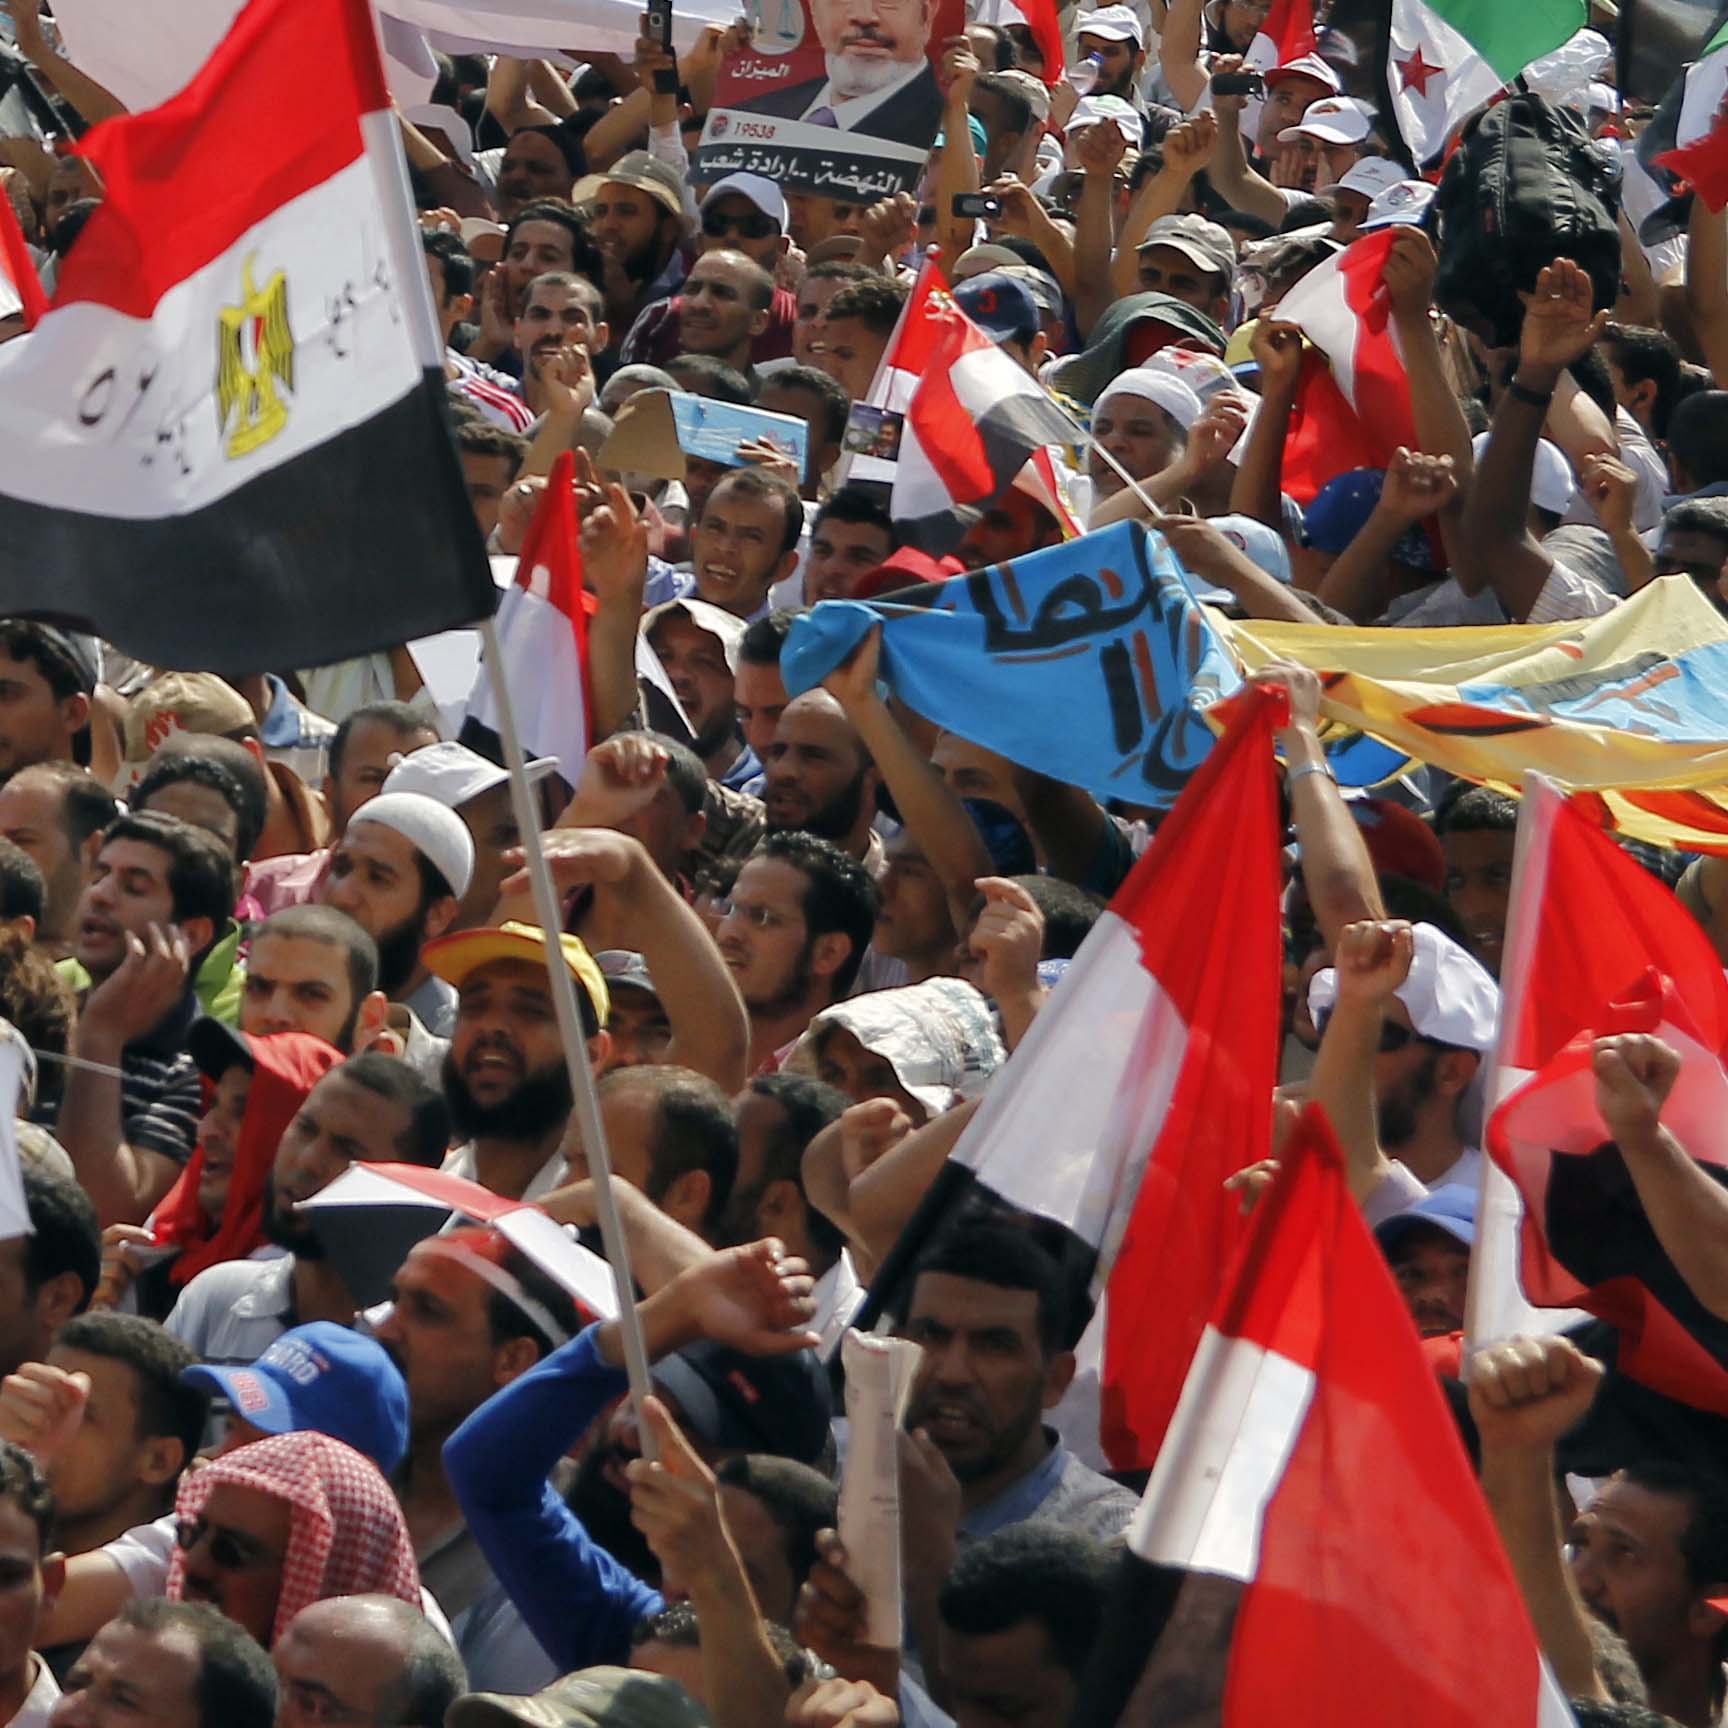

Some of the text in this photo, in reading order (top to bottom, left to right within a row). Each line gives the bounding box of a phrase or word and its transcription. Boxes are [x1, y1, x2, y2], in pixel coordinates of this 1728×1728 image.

[730, 60, 790, 79] الميزان
[698, 147, 745, 171] شعب
[813, 159, 904, 196] النهضة
